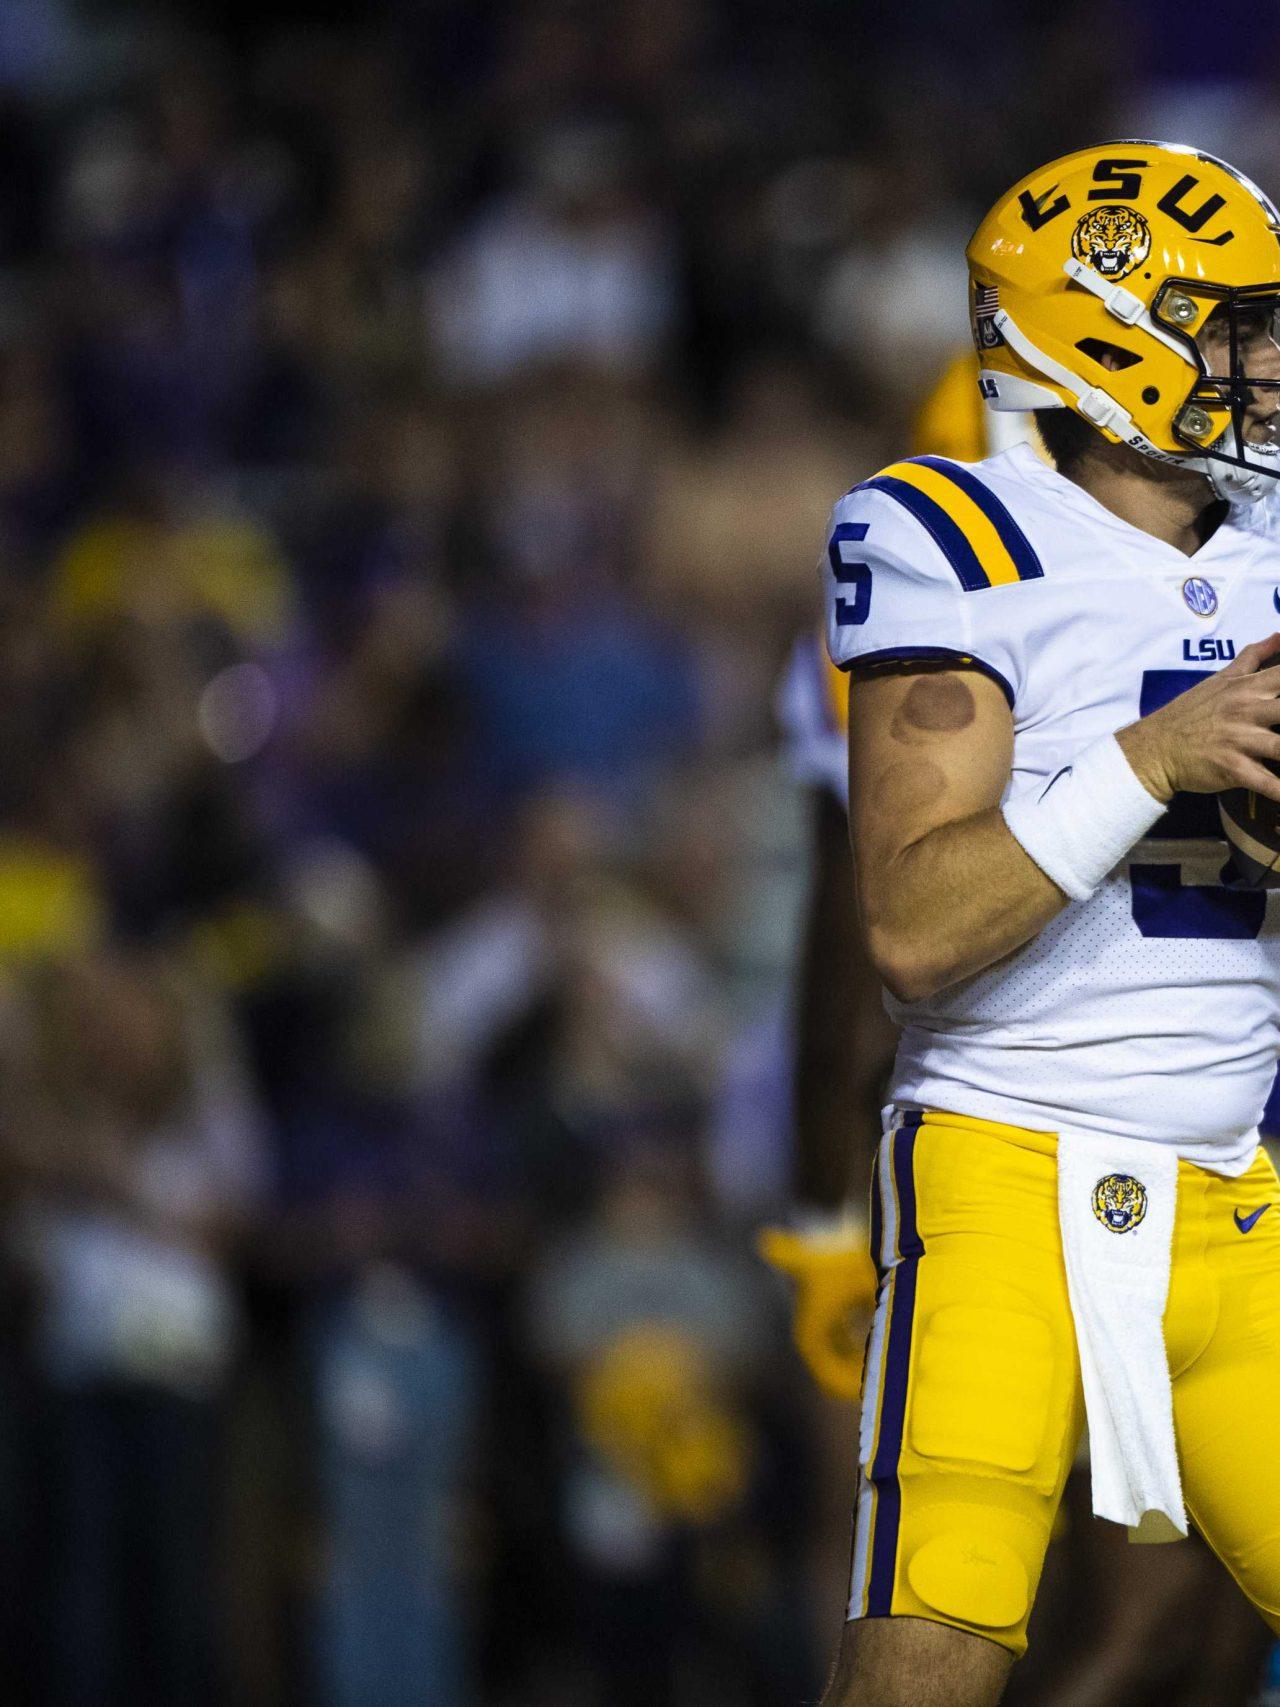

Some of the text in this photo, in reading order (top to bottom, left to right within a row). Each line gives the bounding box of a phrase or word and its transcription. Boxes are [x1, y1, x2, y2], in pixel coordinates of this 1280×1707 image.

[1018, 159, 1235, 246] LSU
[828, 522, 872, 625] 5
[1182, 638, 1235, 661] LSU
